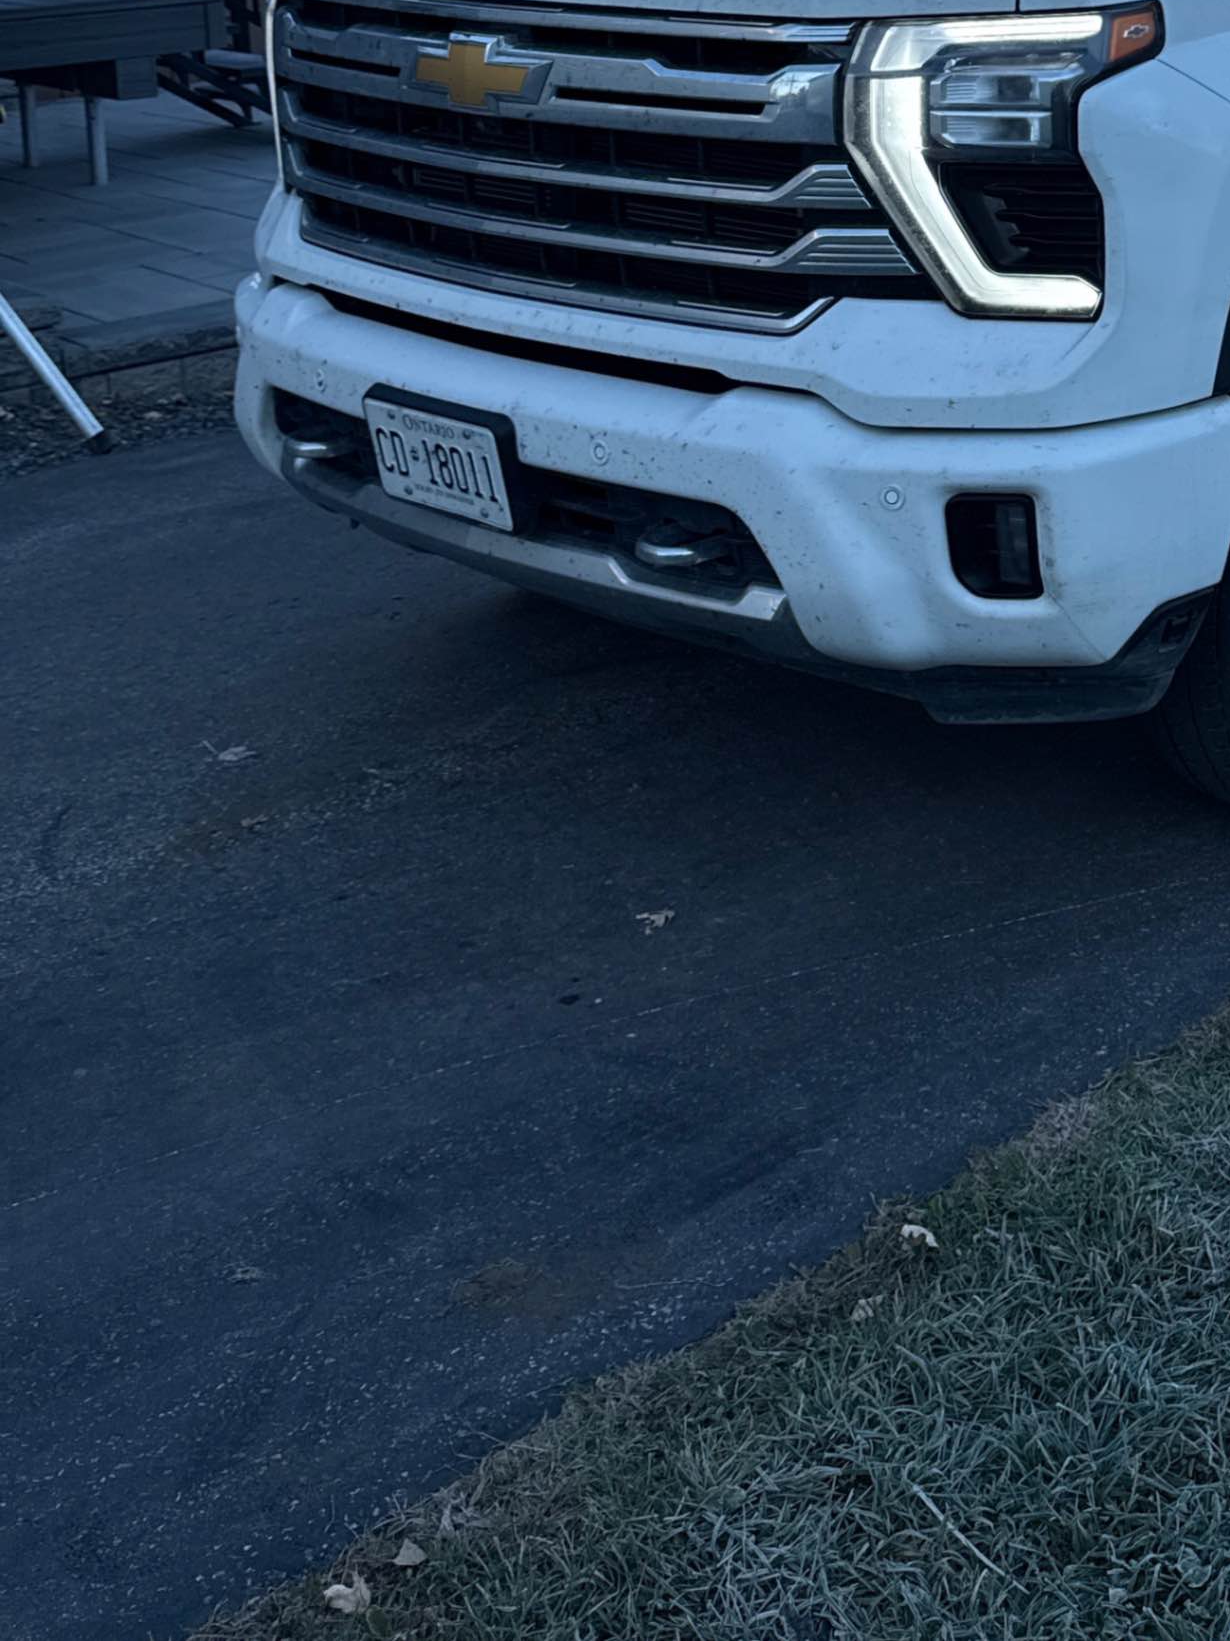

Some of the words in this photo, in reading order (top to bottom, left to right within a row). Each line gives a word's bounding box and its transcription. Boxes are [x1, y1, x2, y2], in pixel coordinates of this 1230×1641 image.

[402, 414, 456, 439] ONTARIO
[375, 426, 410, 477] CD
[421, 438, 500, 503] 18011
